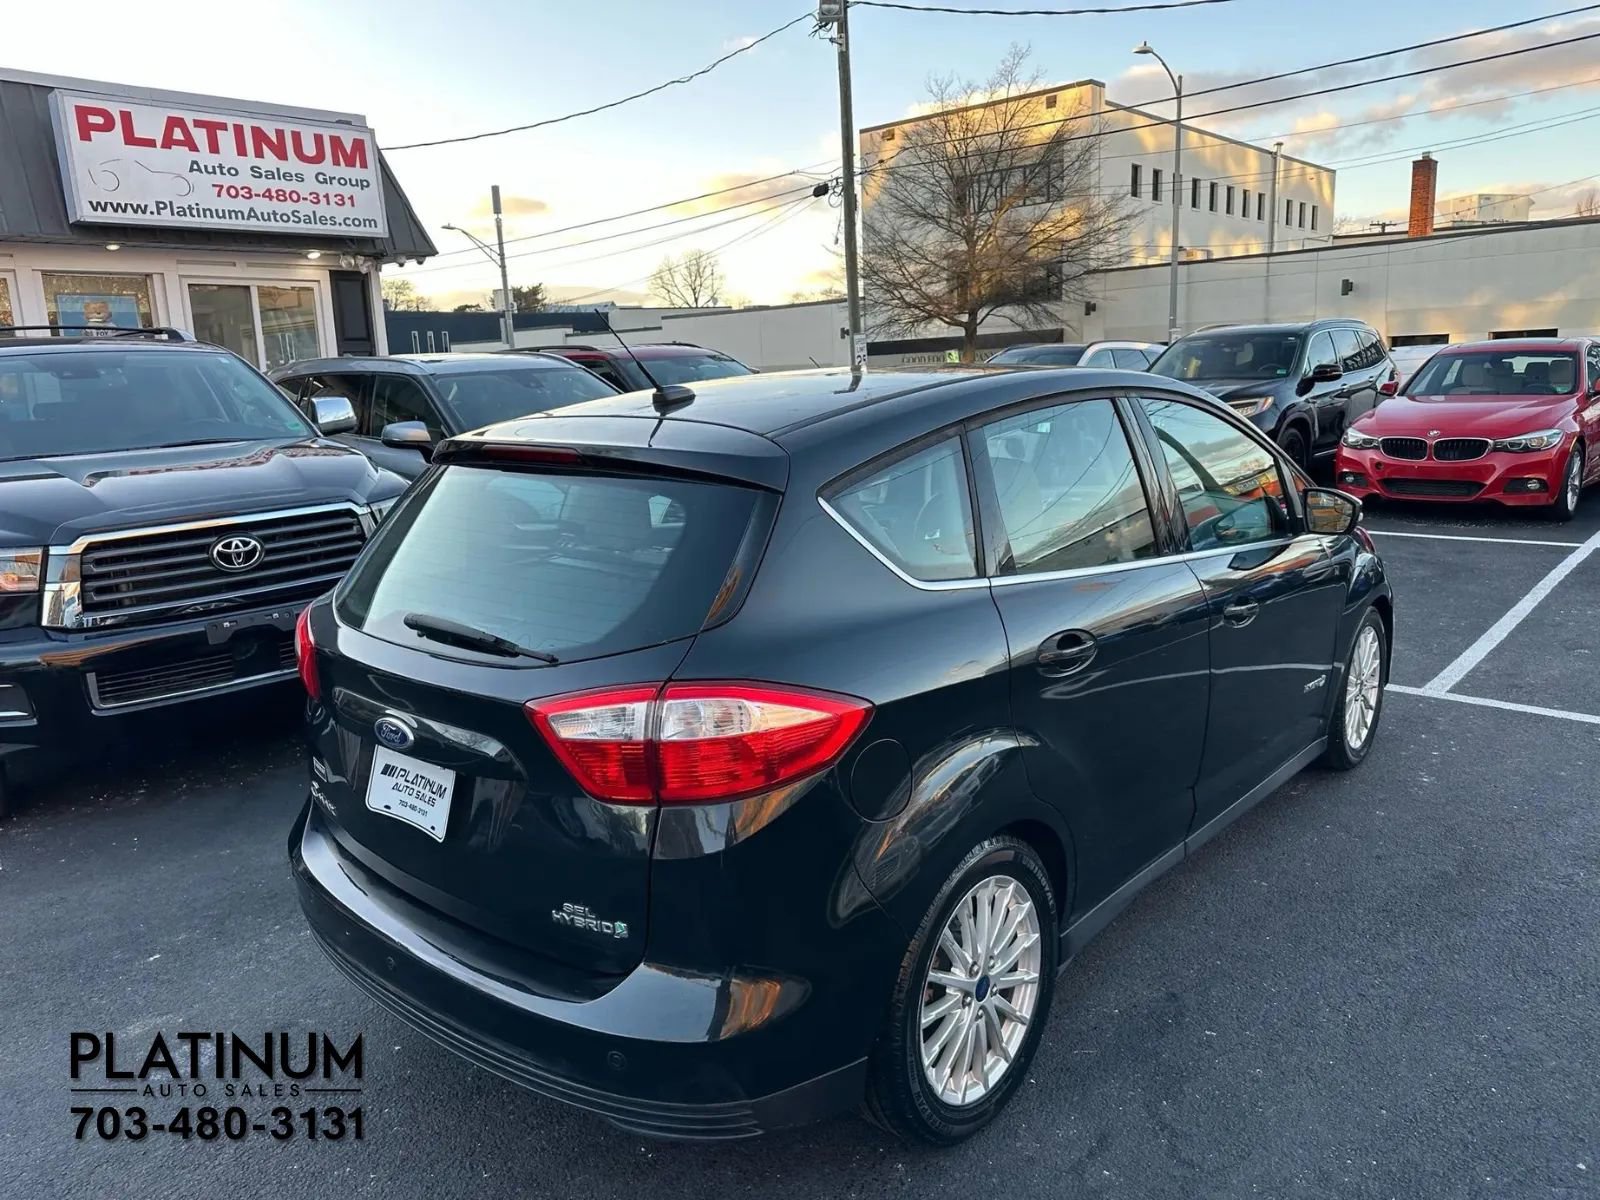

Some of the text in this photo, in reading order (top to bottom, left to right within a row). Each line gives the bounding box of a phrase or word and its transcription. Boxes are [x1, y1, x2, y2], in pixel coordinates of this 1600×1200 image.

[74, 104, 369, 169] PLATINUM
[188, 159, 371, 191] Auto Sales Group
[212, 183, 356, 208] 703-480-3131
[88, 200, 378, 229] www.PlatinumAutoSales.com
[381, 722, 402, 743] Ford
[392, 782, 436, 807] AUTO SALES
[396, 768, 447, 799] PLATINUM
[552, 910, 614, 934] HYBRID
[563, 903, 595, 918] SEL
